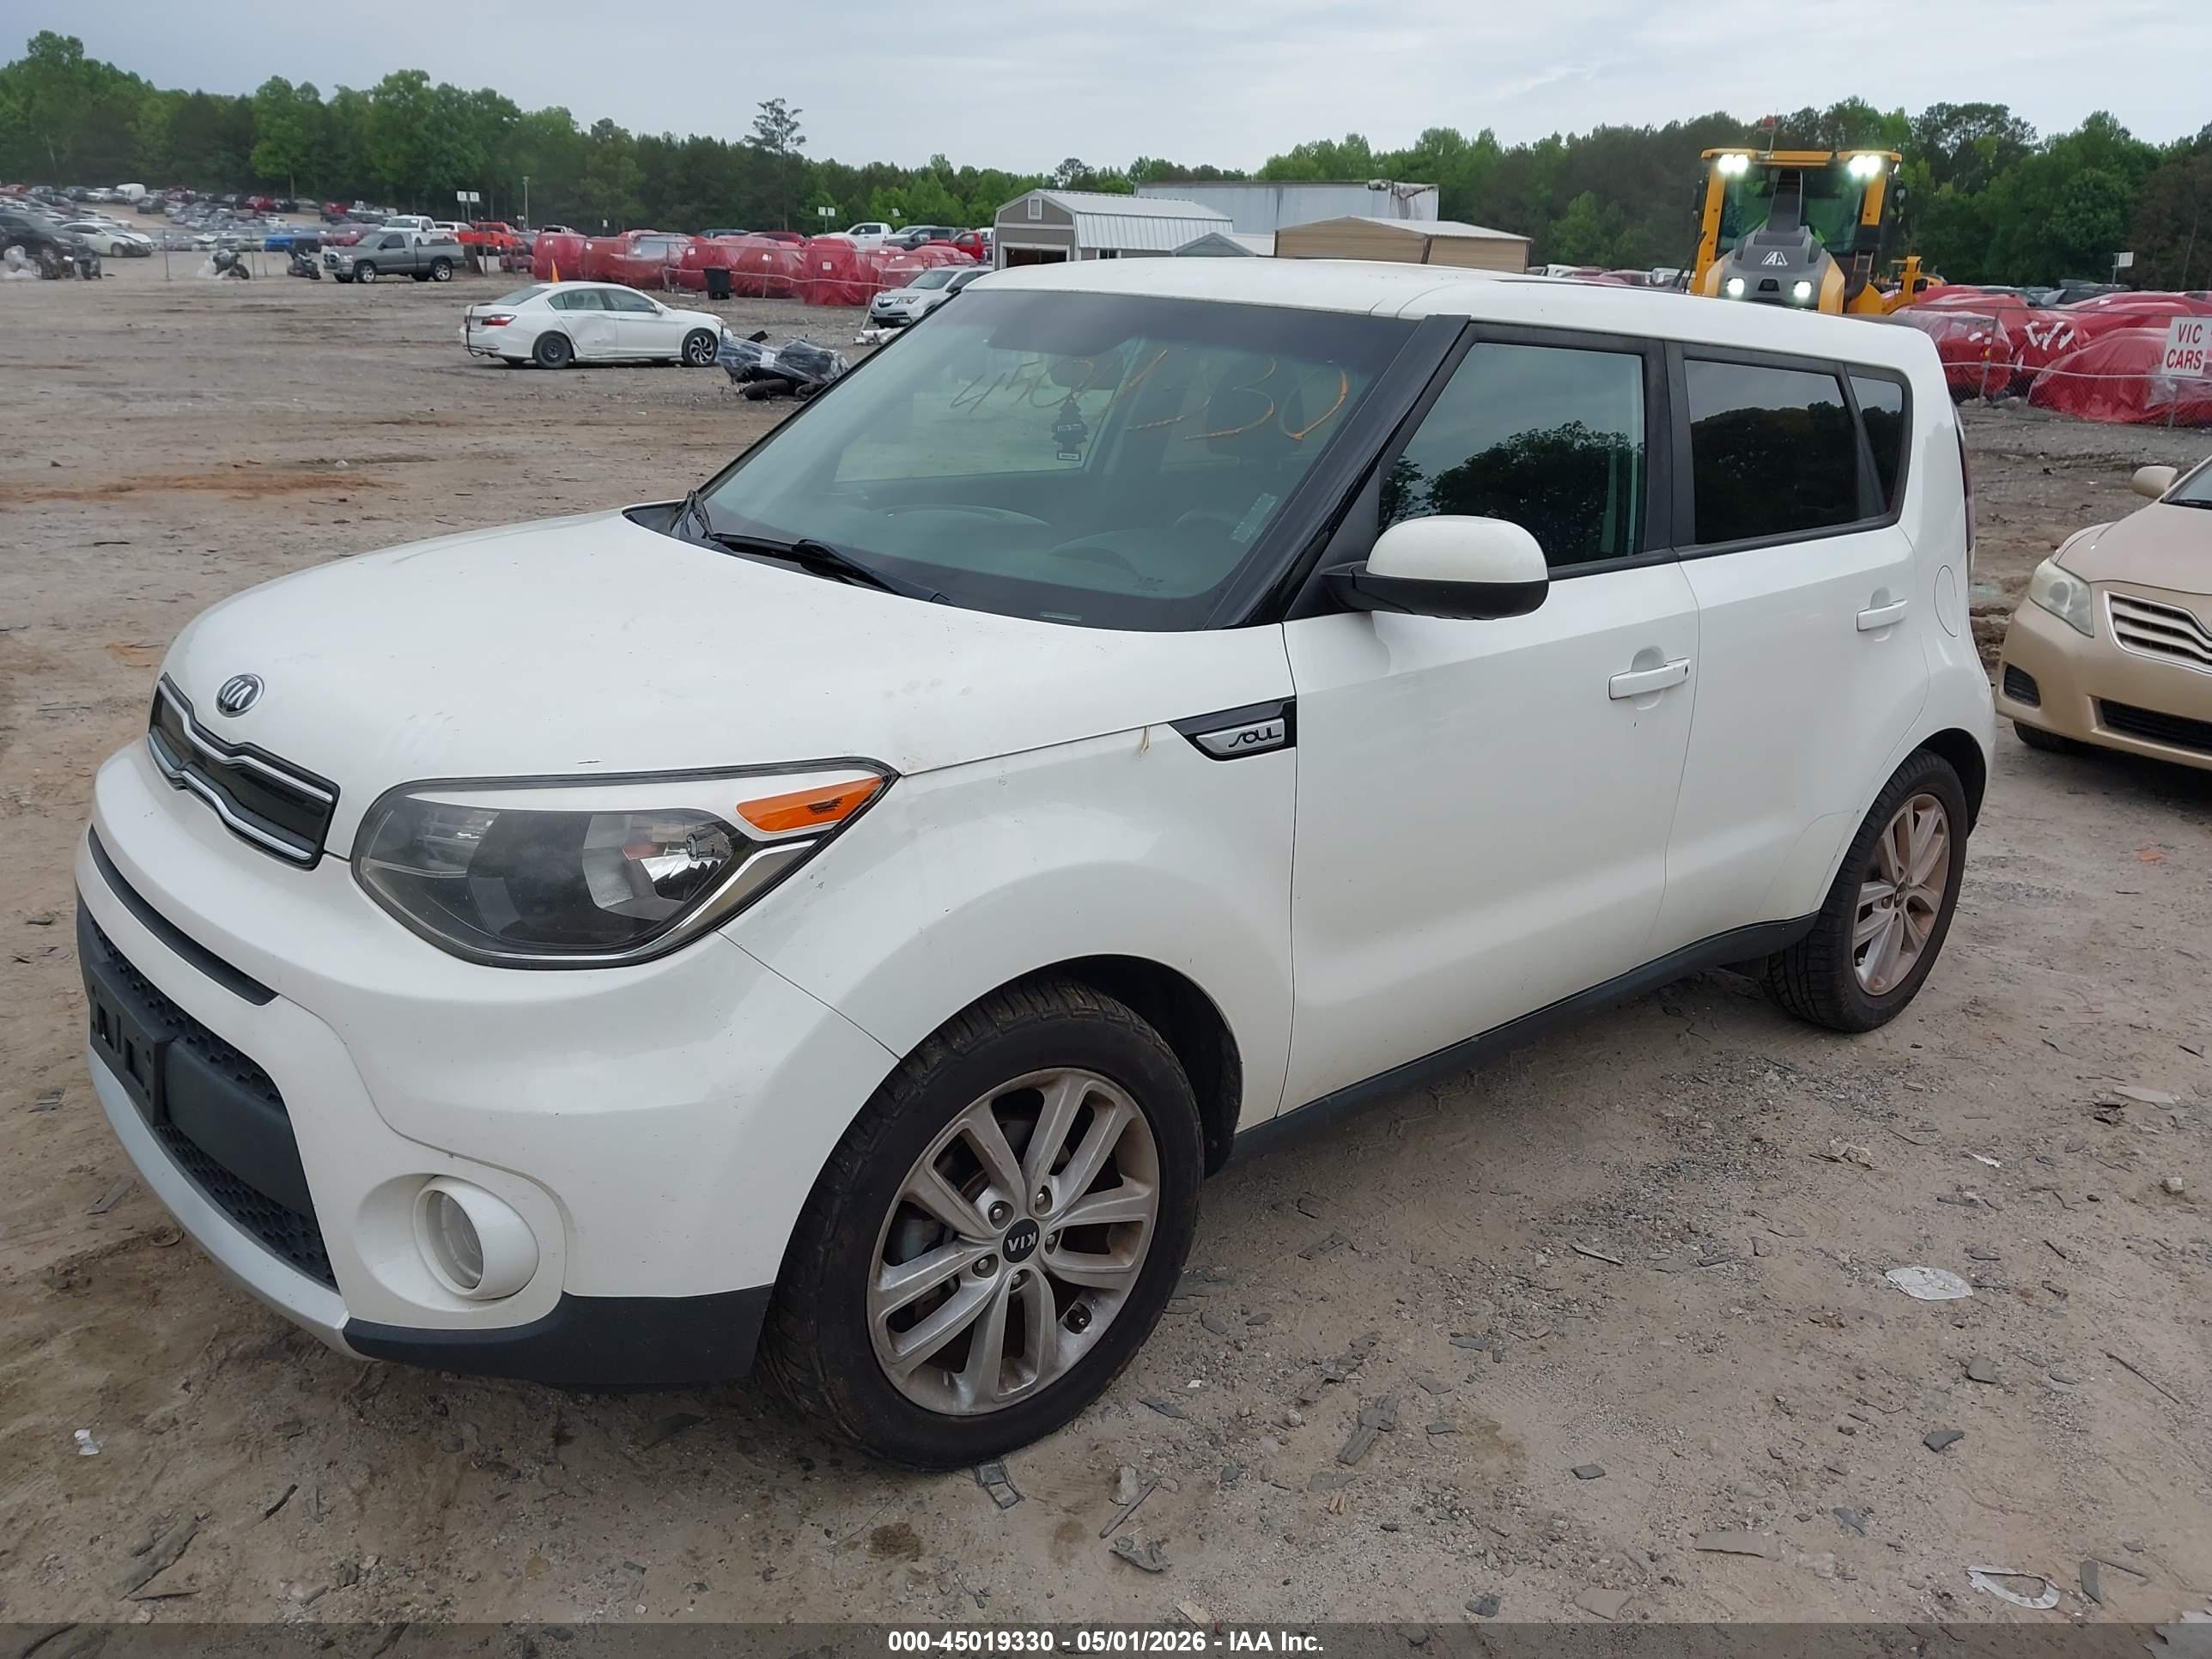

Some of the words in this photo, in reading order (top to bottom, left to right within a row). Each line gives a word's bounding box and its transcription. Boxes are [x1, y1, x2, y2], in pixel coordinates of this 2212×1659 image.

[2178, 323, 2203, 344] VIC
[2166, 349, 2203, 370] CARS
[1227, 726, 1282, 749] SOUL
[1007, 1231, 1037, 1253] KIA
